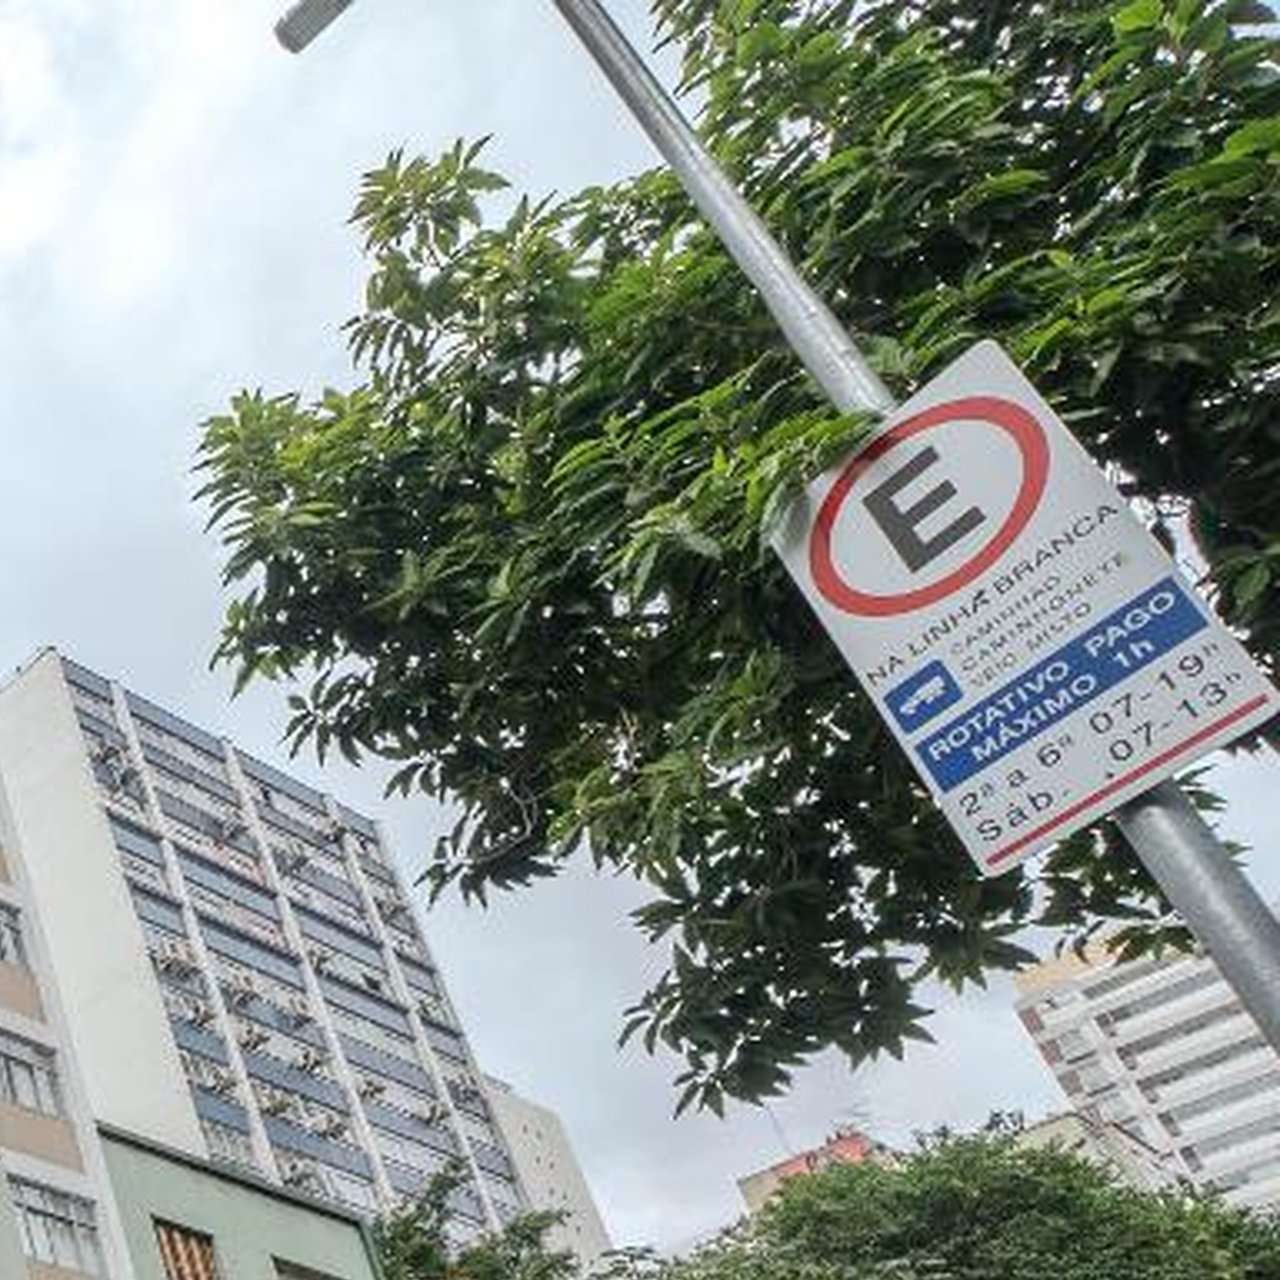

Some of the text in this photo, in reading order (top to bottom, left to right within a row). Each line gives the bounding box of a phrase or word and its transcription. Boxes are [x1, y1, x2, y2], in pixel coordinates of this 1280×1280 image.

[863, 446, 987, 574] E
[866, 505, 1119, 686] NA LINHA BRANCA
[928, 591, 1176, 760] ROTATIVO PAGO
[970, 640, 1156, 762] MÁXIMO 1h
[1007, 768, 1029, 790] a
